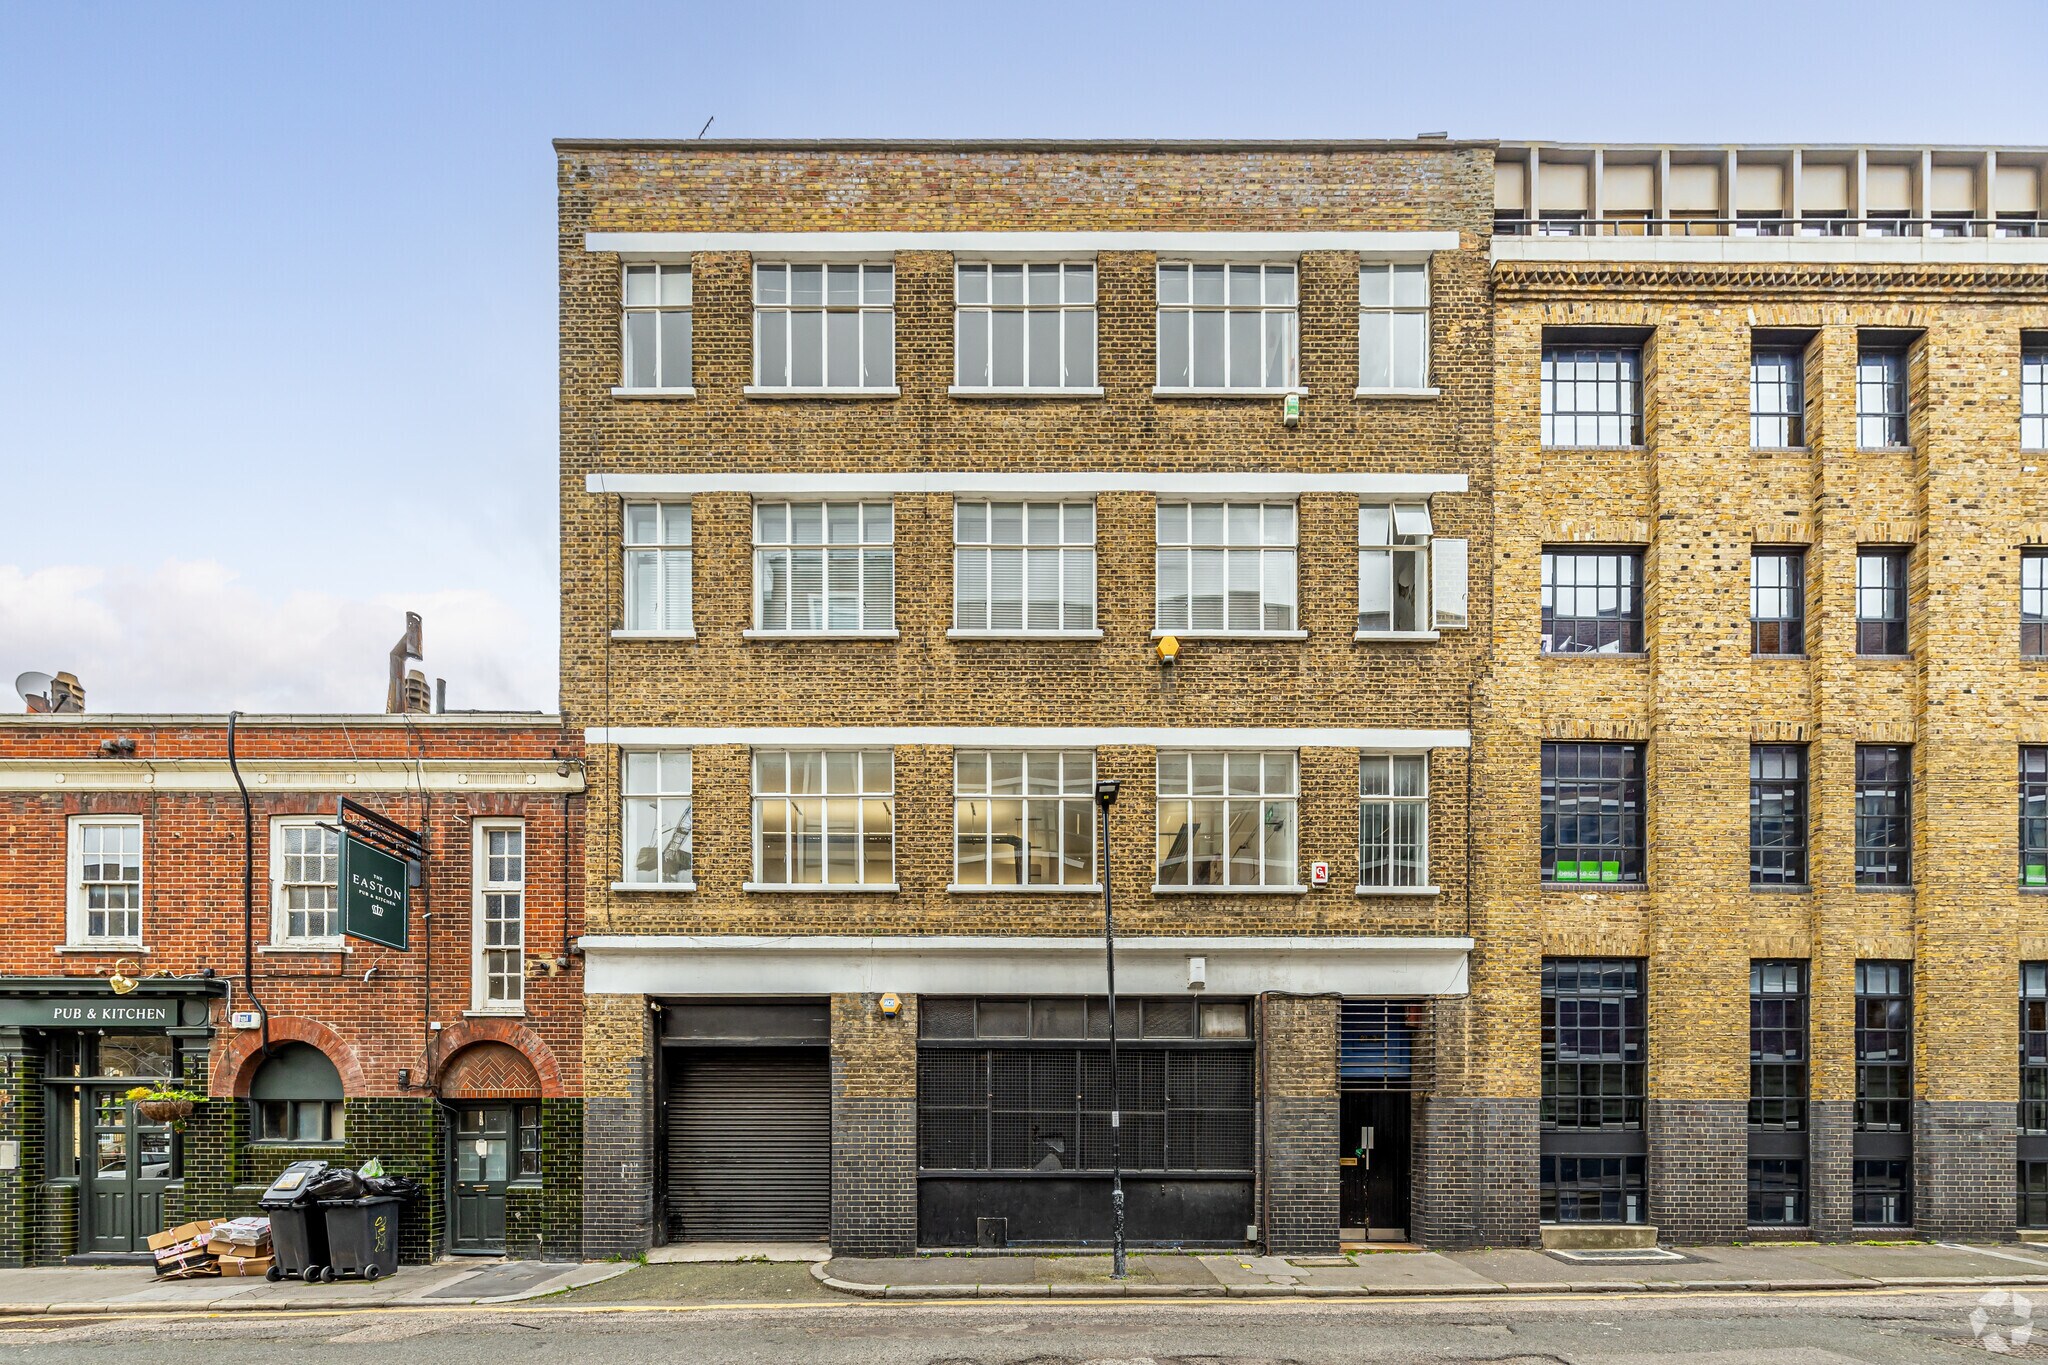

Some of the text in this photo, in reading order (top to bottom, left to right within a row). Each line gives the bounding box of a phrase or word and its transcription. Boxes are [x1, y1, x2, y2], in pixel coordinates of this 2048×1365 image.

[352, 873, 402, 900] EASTON
[375, 895, 396, 906] KITCHEN
[53, 1008, 166, 1019] PUB & KITCHEN
